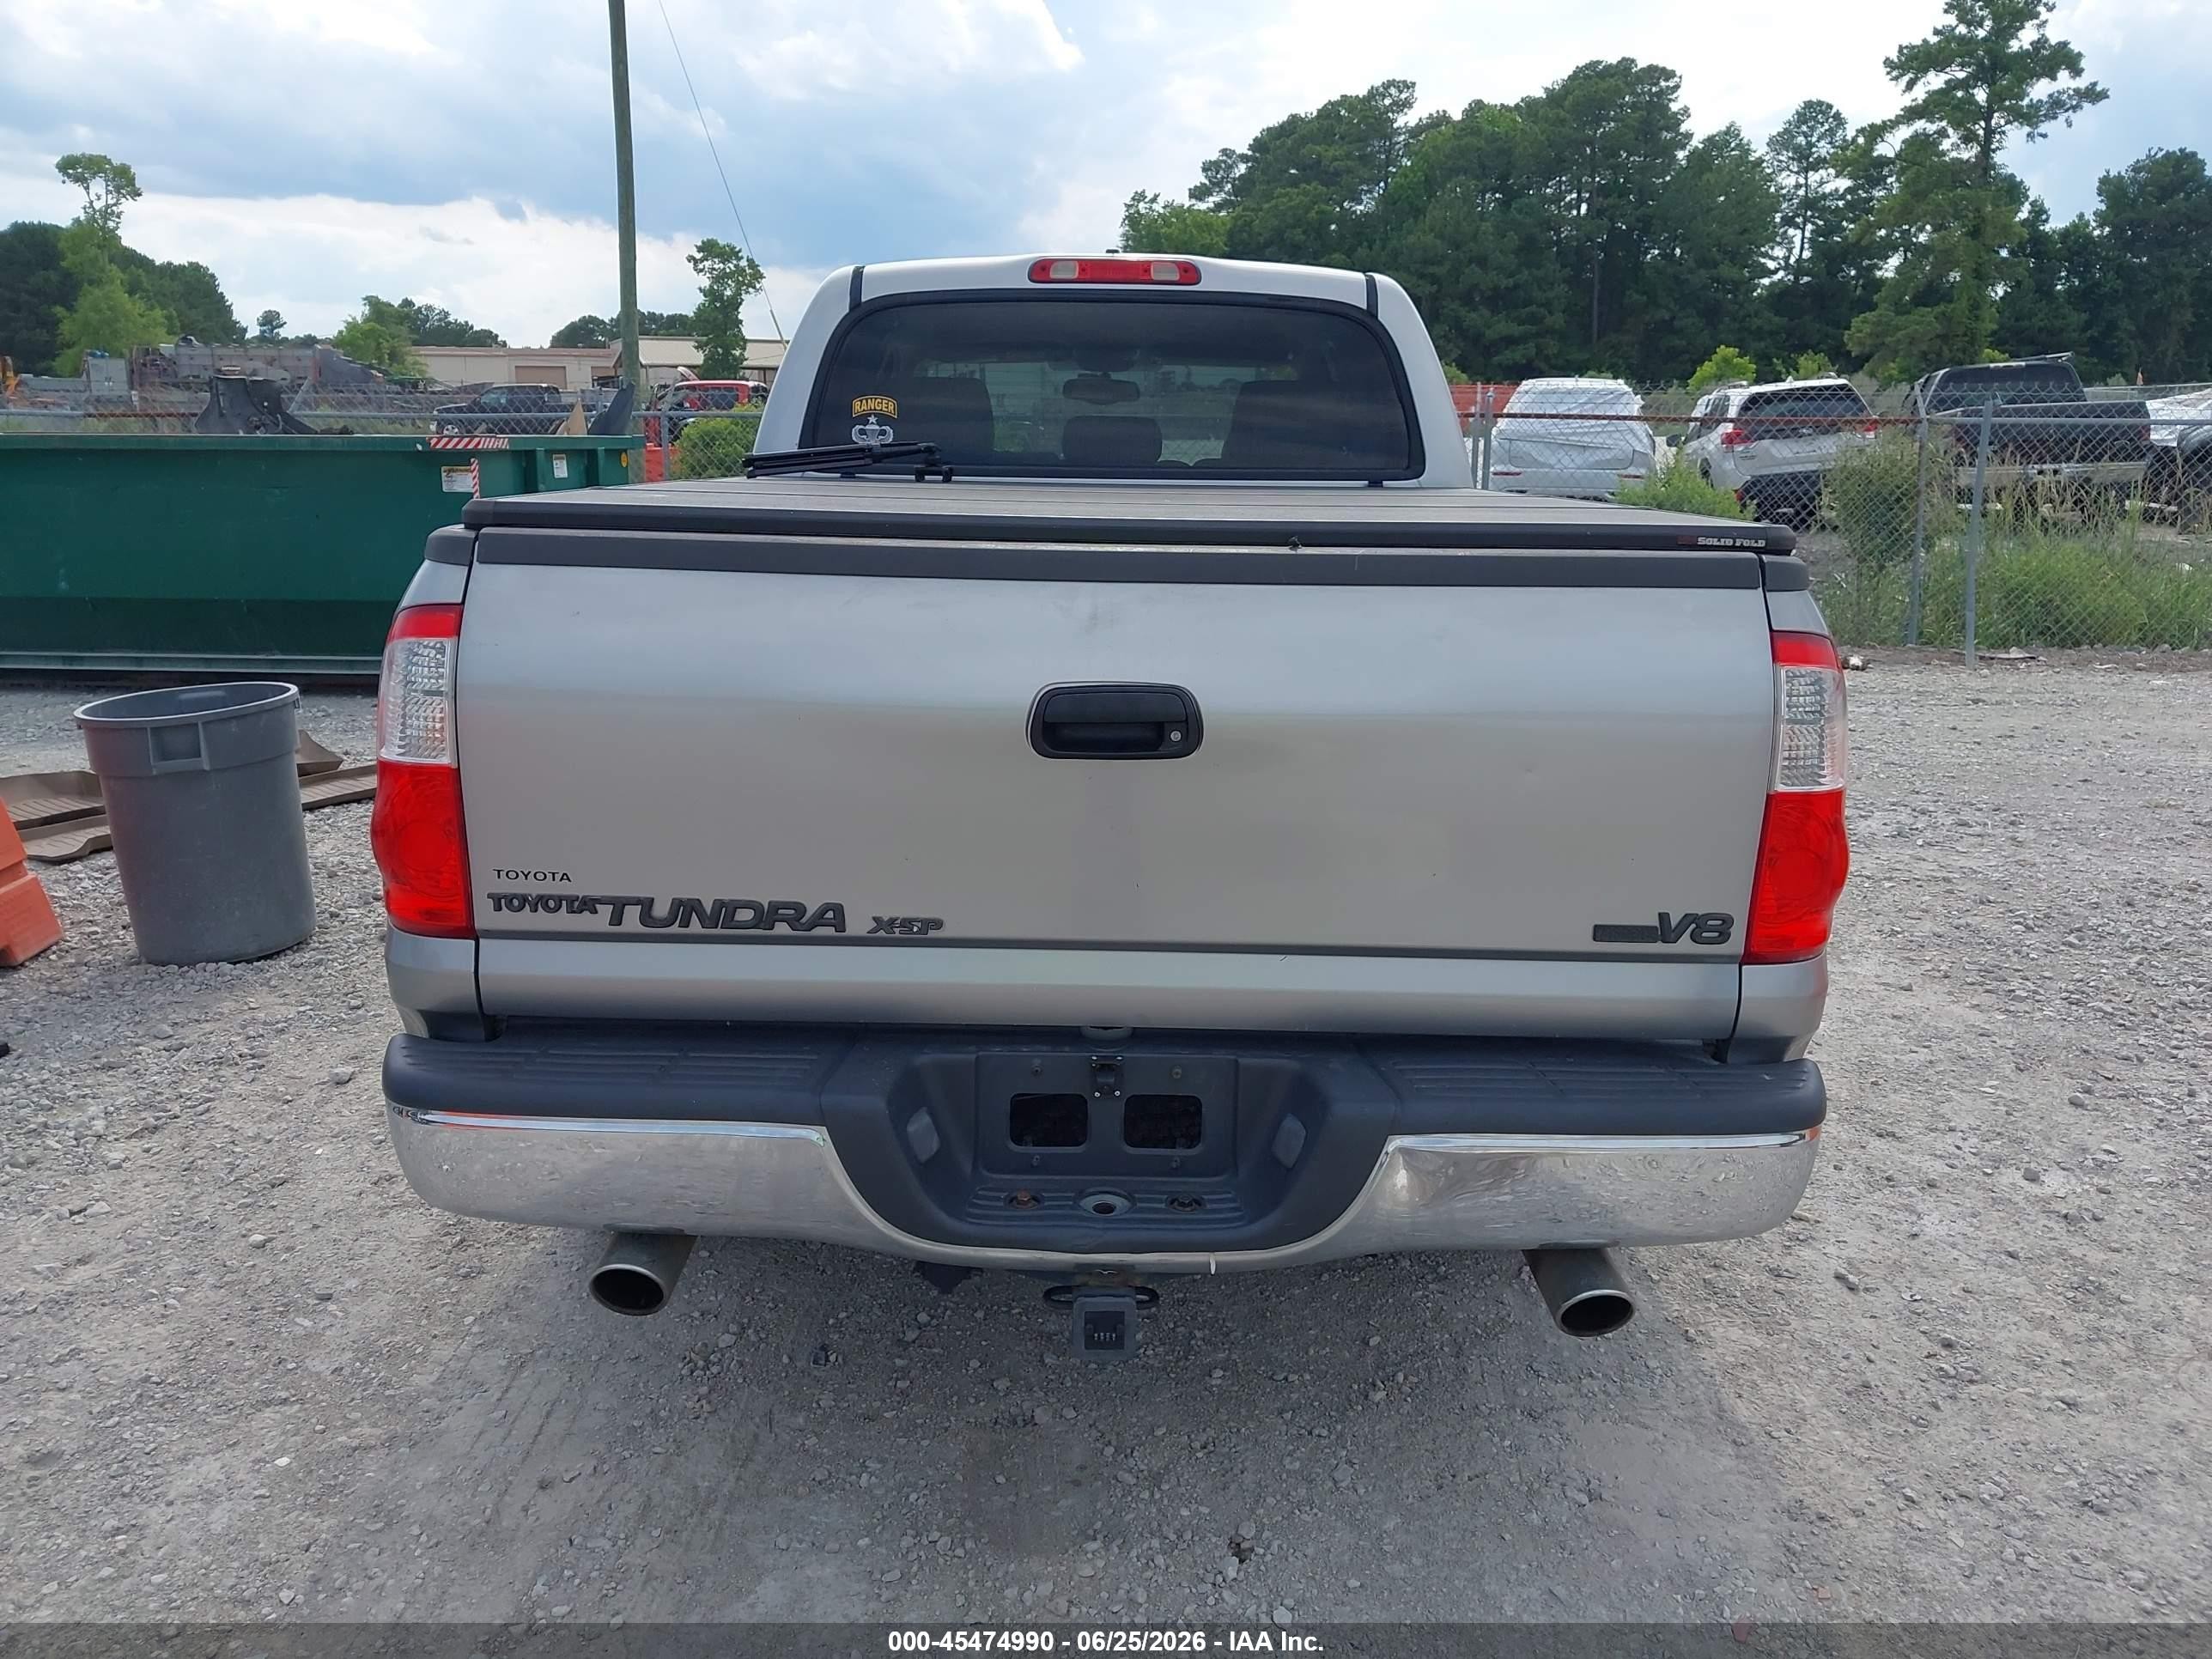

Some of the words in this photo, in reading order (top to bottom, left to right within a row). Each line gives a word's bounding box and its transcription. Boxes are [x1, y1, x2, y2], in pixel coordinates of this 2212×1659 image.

[854, 398, 895, 414] RANGER
[1697, 537, 1734, 546] SOLID
[1735, 538, 1766, 547] FOLD
[493, 869, 572, 882] TOYOTA
[487, 893, 599, 915] TOYOTA
[587, 895, 847, 933] TUNDRA
[1658, 912, 1734, 945] V8
